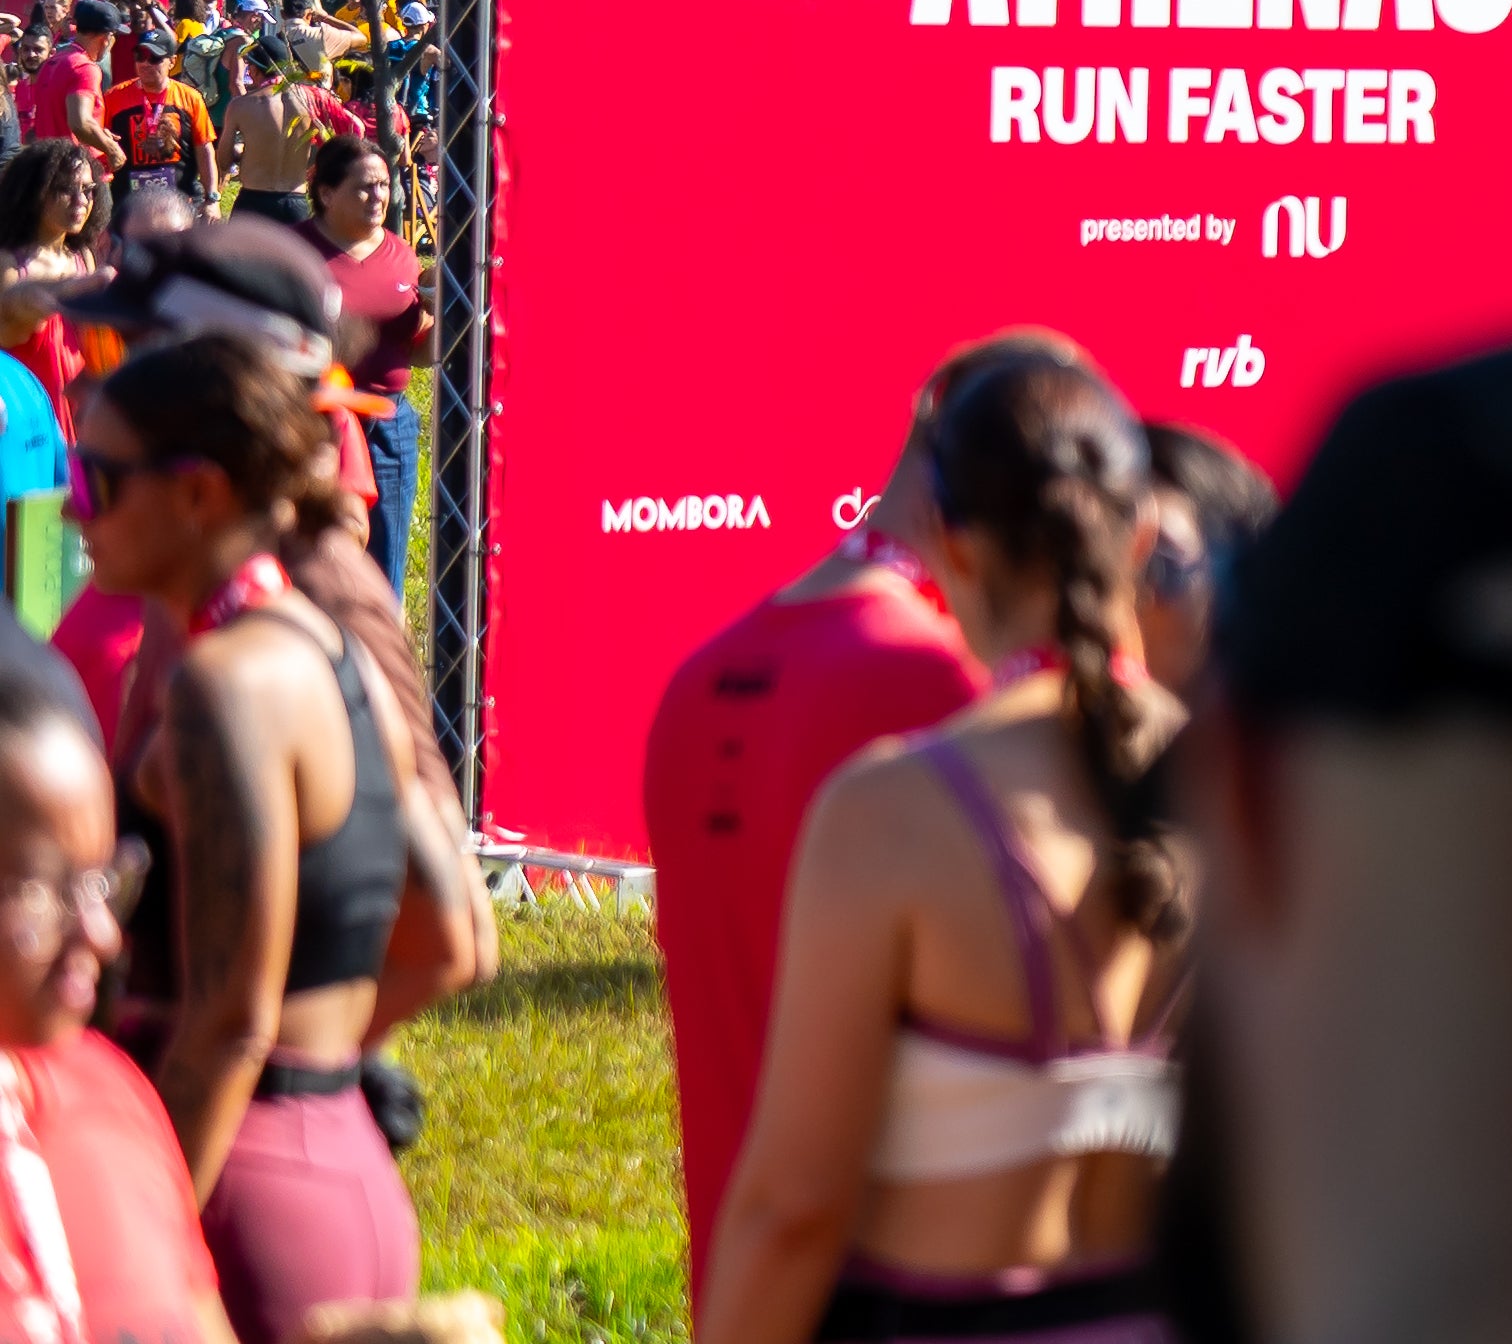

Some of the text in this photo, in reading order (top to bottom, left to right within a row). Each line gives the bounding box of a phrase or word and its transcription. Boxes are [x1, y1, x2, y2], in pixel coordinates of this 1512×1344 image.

[989, 65, 1437, 145] RUN FASTER
[1080, 213, 1201, 247] presented
[1205, 213, 1236, 247] by
[1180, 333, 1266, 389] rvb
[601, 494, 772, 534] MOMBORA
